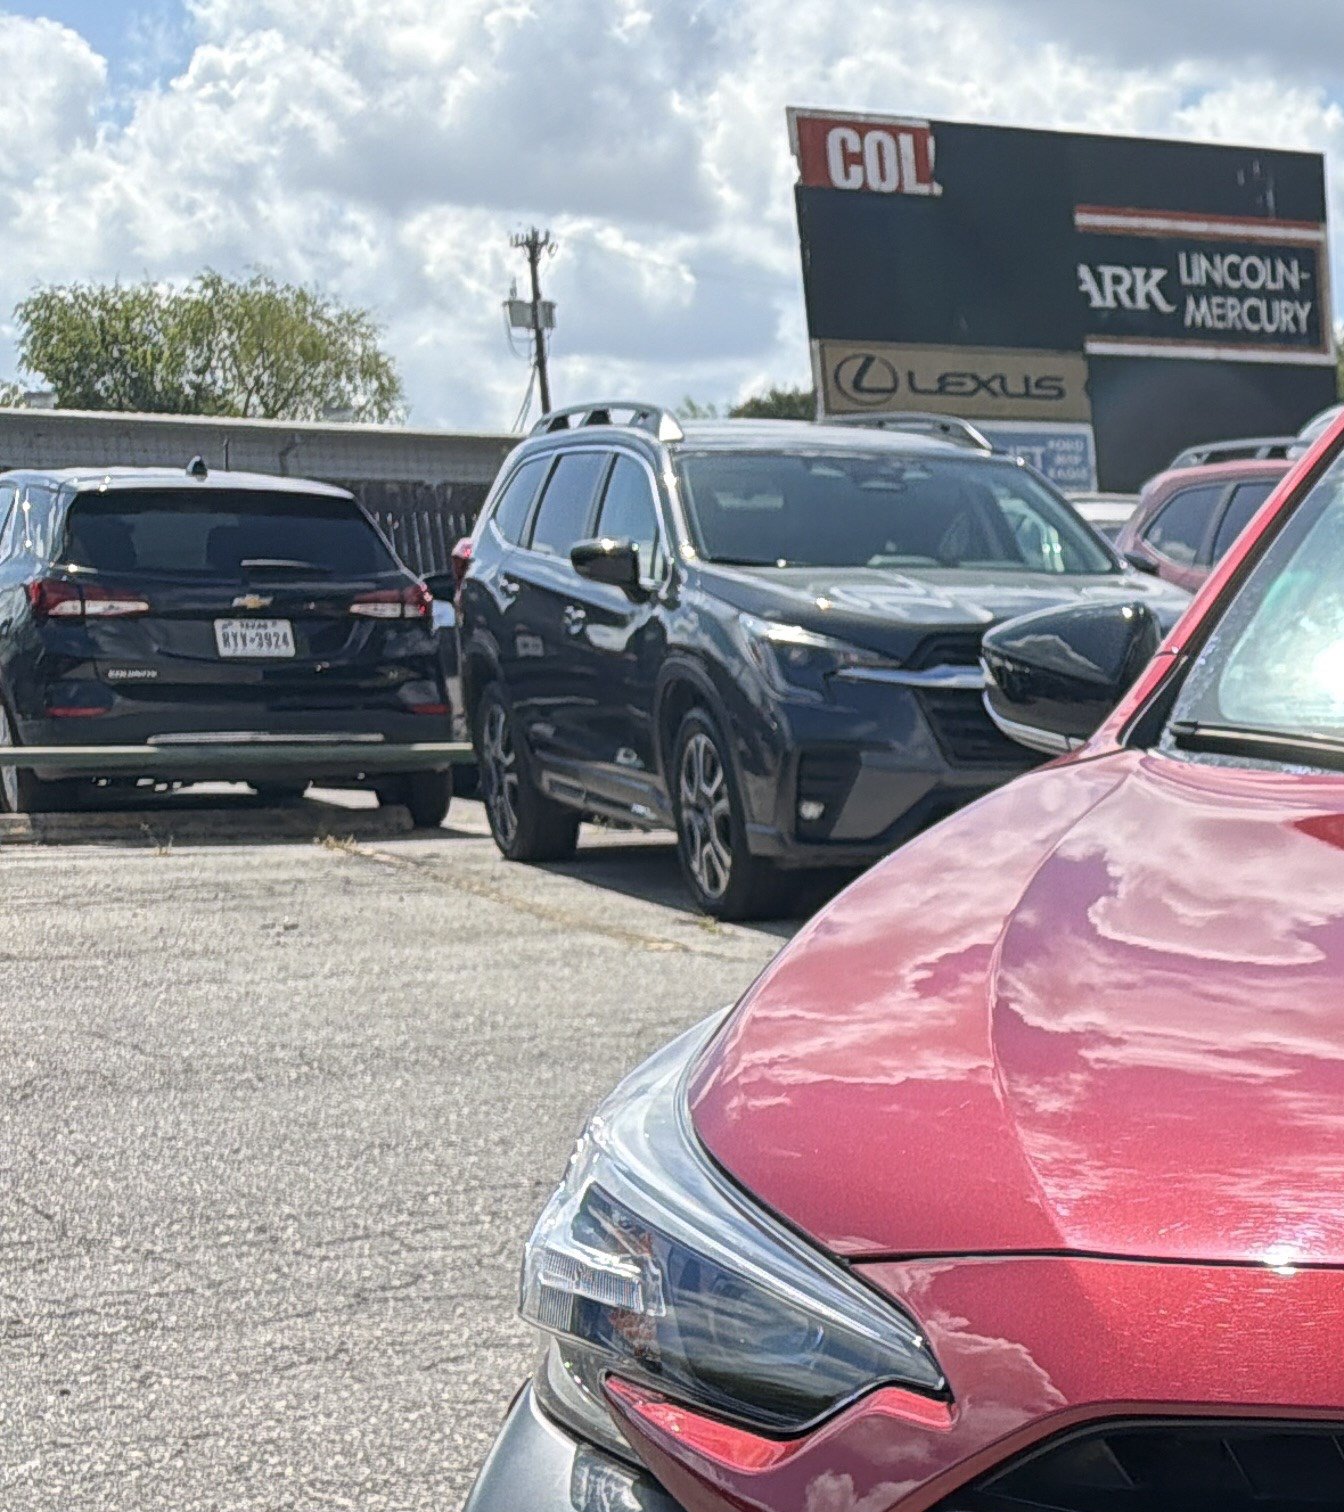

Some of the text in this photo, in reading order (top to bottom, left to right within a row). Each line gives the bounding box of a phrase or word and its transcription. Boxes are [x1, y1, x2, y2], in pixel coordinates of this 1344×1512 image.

[827, 126, 943, 197] COL
[1184, 294, 1312, 334] MERCURY
[907, 370, 1066, 399] LEXUS
